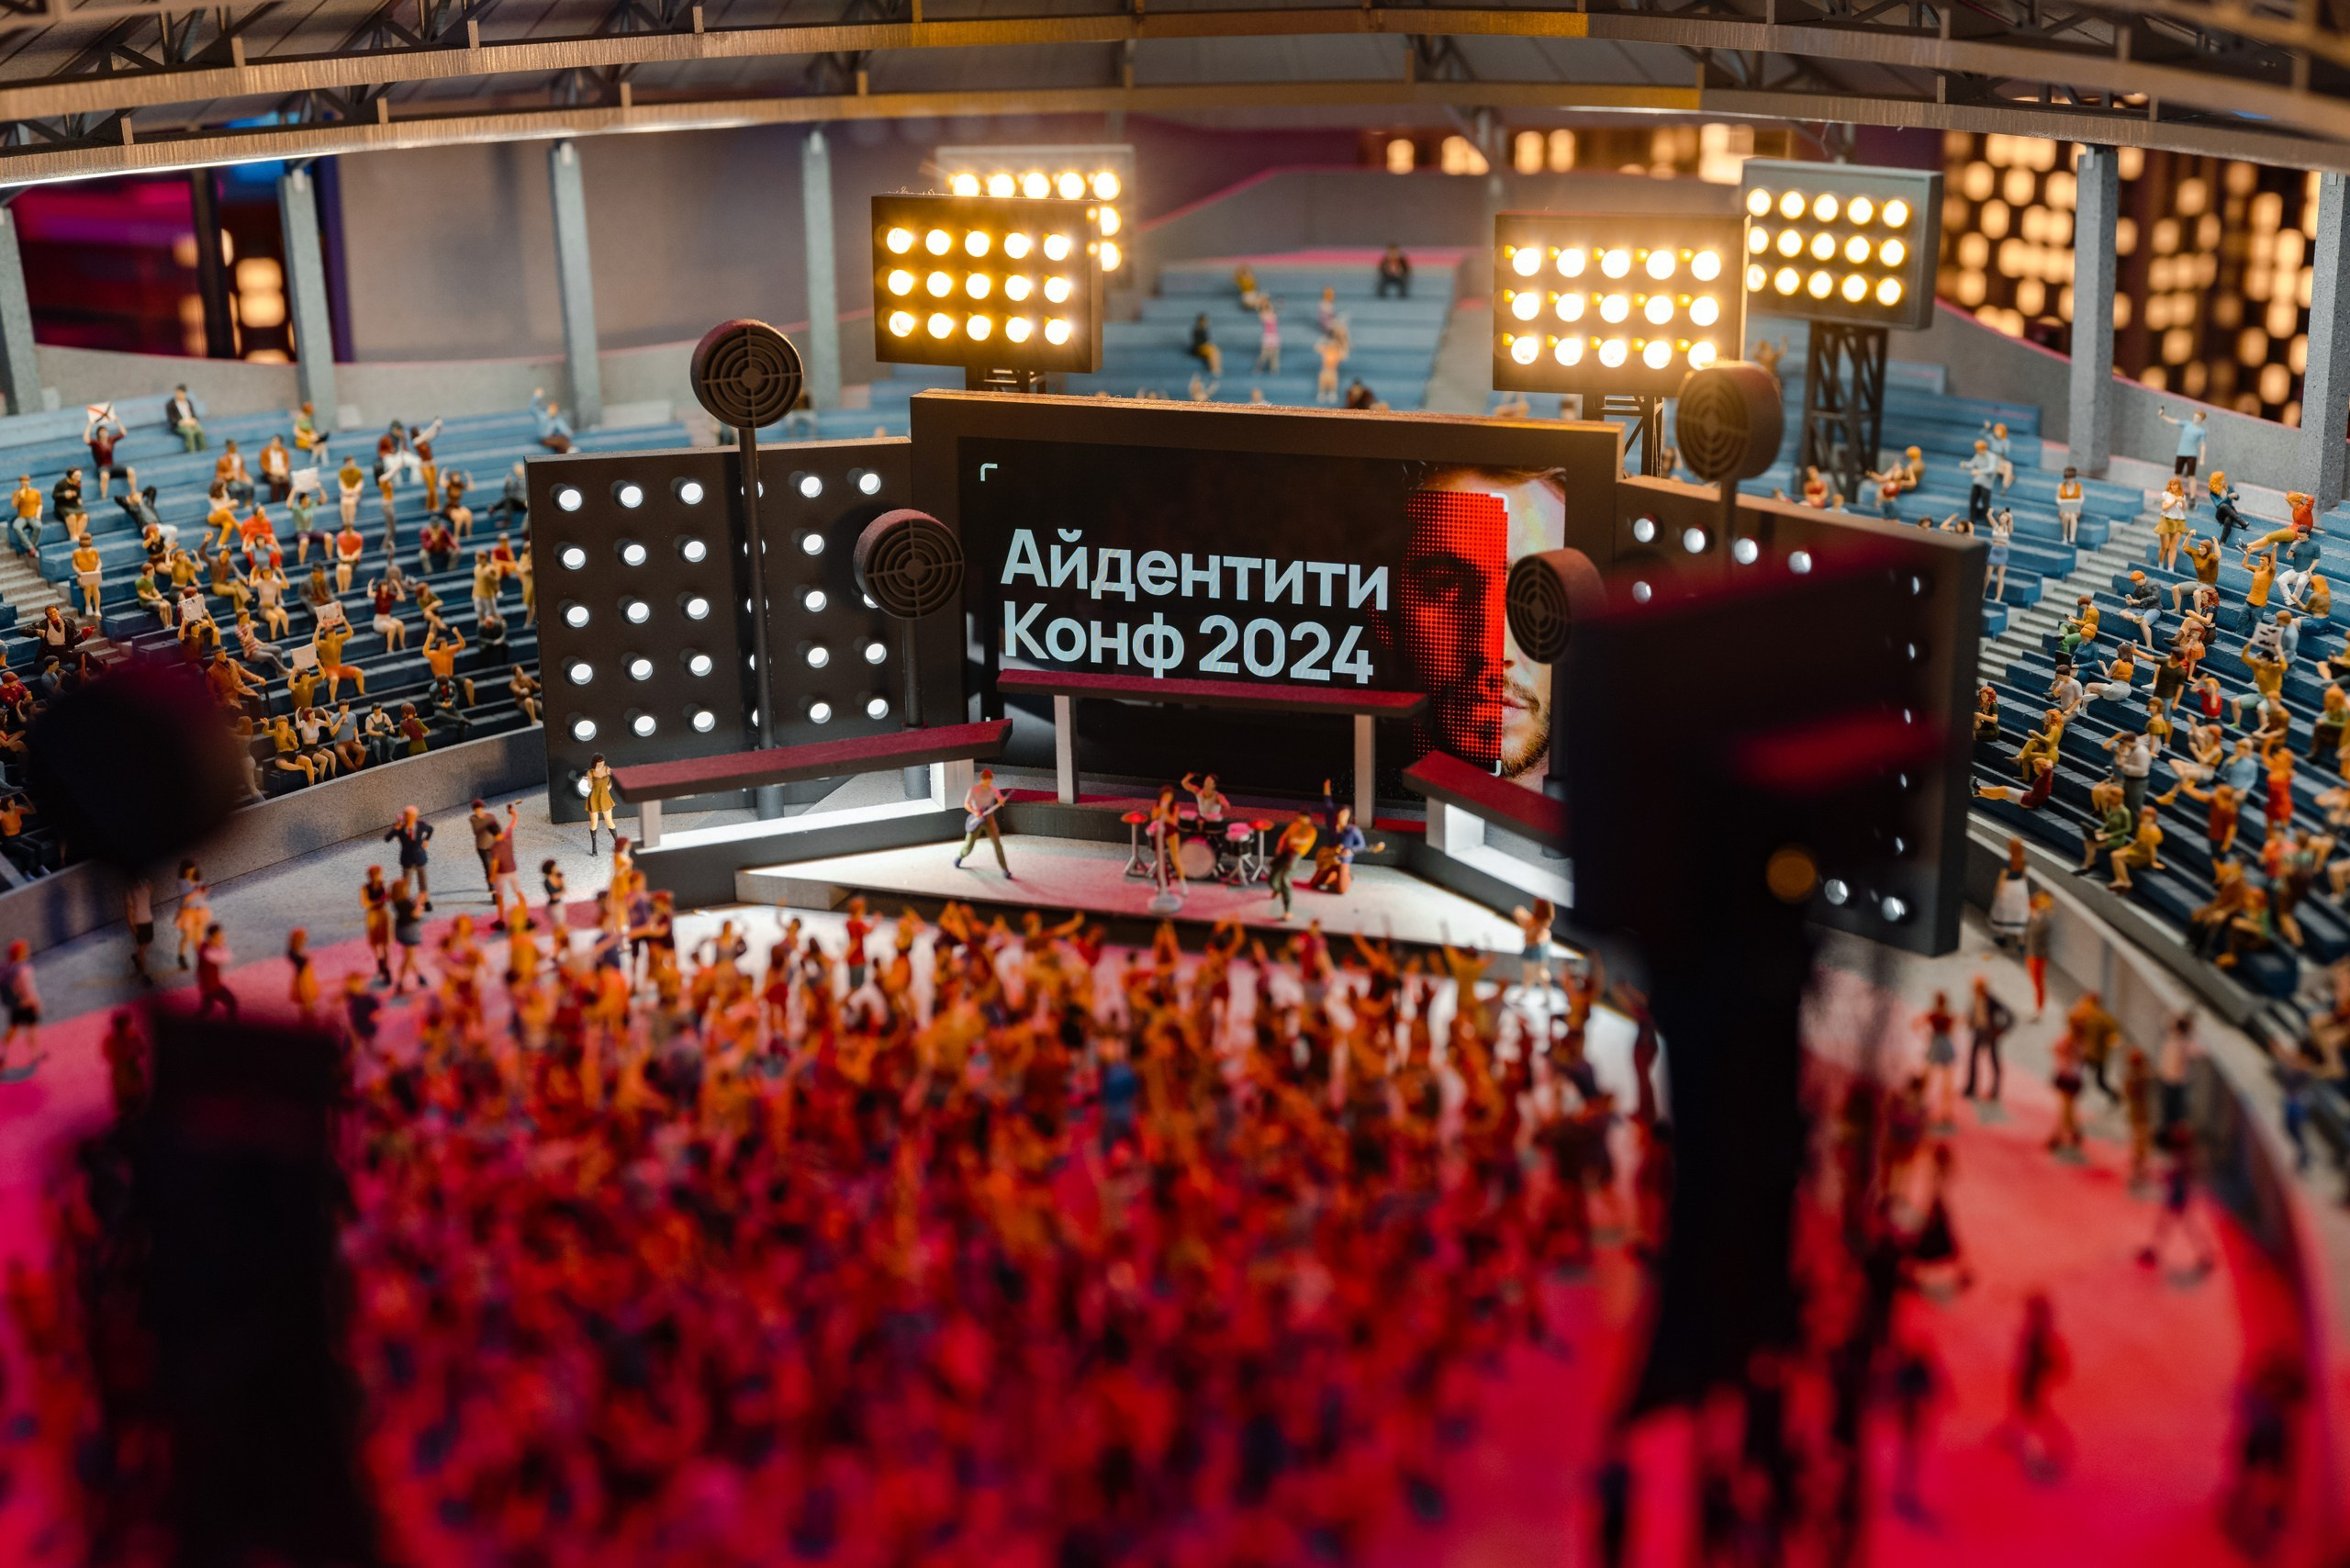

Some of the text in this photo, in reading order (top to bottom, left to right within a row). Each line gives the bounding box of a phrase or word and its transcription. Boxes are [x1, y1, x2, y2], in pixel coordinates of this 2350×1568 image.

[1000, 528, 1389, 611] Айдентити
[1003, 600, 1374, 685] Конф 2024
